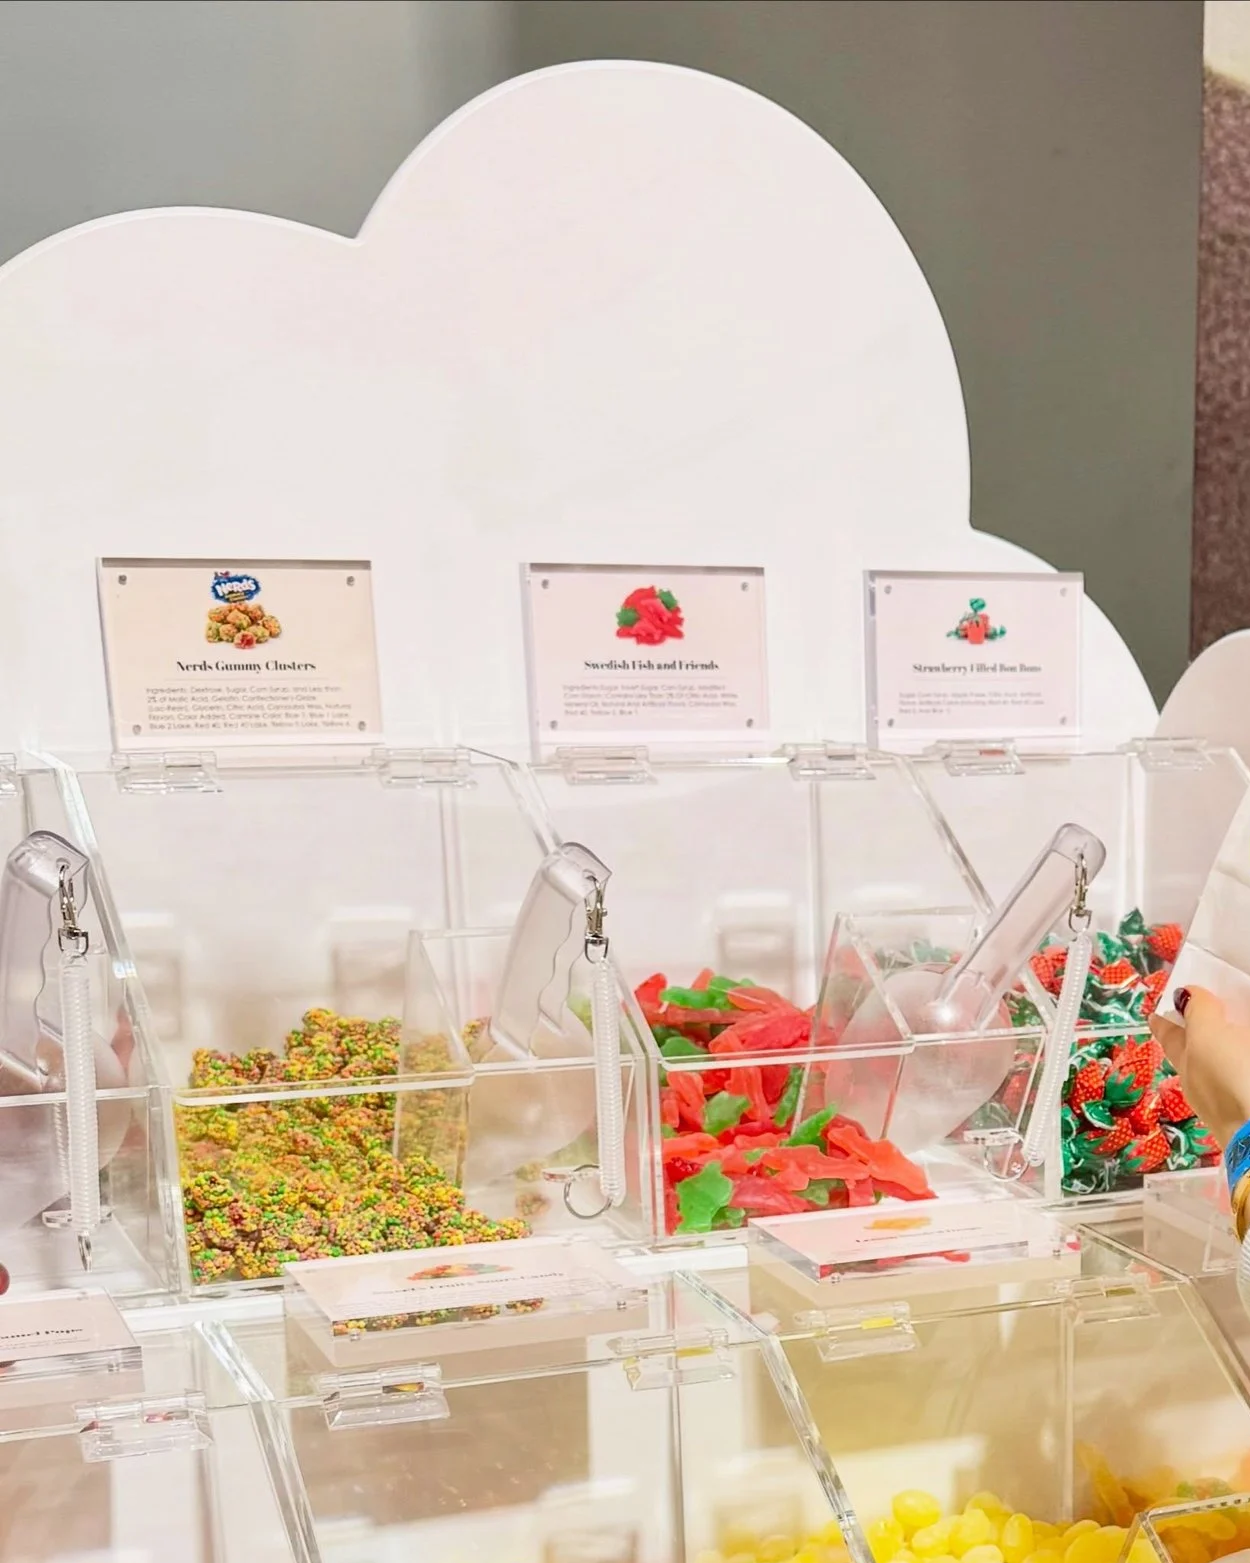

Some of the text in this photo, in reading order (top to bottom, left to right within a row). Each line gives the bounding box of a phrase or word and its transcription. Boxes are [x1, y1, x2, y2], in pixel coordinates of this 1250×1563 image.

[177, 660, 316, 674] Nerds Gummy Clusters
[584, 660, 719, 670] Swedish Fish and Friends
[913, 662, 967, 676] Strawberry
[970, 663, 997, 672] Filled
[999, 663, 1017, 672] Bon
